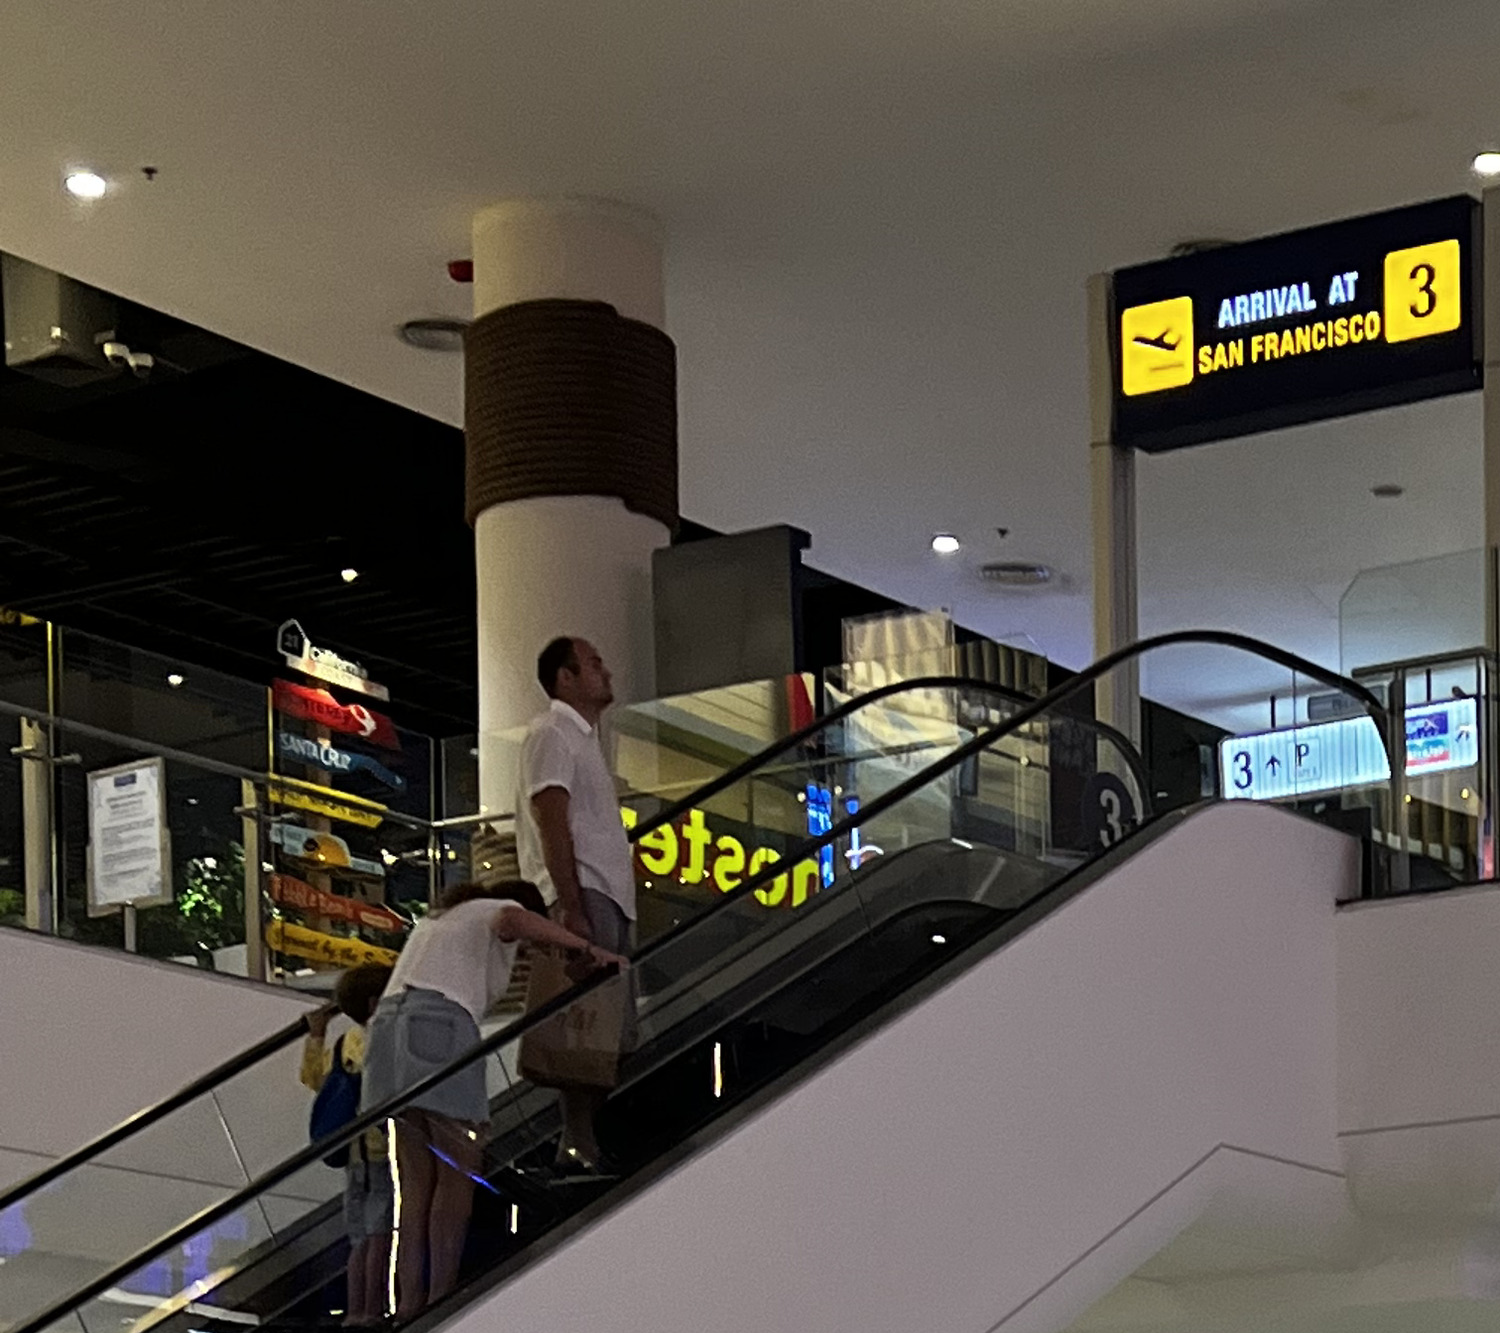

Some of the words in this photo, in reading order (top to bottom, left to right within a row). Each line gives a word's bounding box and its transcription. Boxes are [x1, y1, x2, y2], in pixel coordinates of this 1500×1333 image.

[1218, 282, 1317, 330] ARRIVAL
[1329, 271, 1359, 306] AT
[1409, 263, 1437, 319] 3
[1199, 339, 1244, 375] SAN
[1251, 310, 1381, 364] FRANCISCO
[1232, 751, 1254, 790] 3
[1294, 743, 1311, 766] P
[1099, 787, 1123, 848] 3
